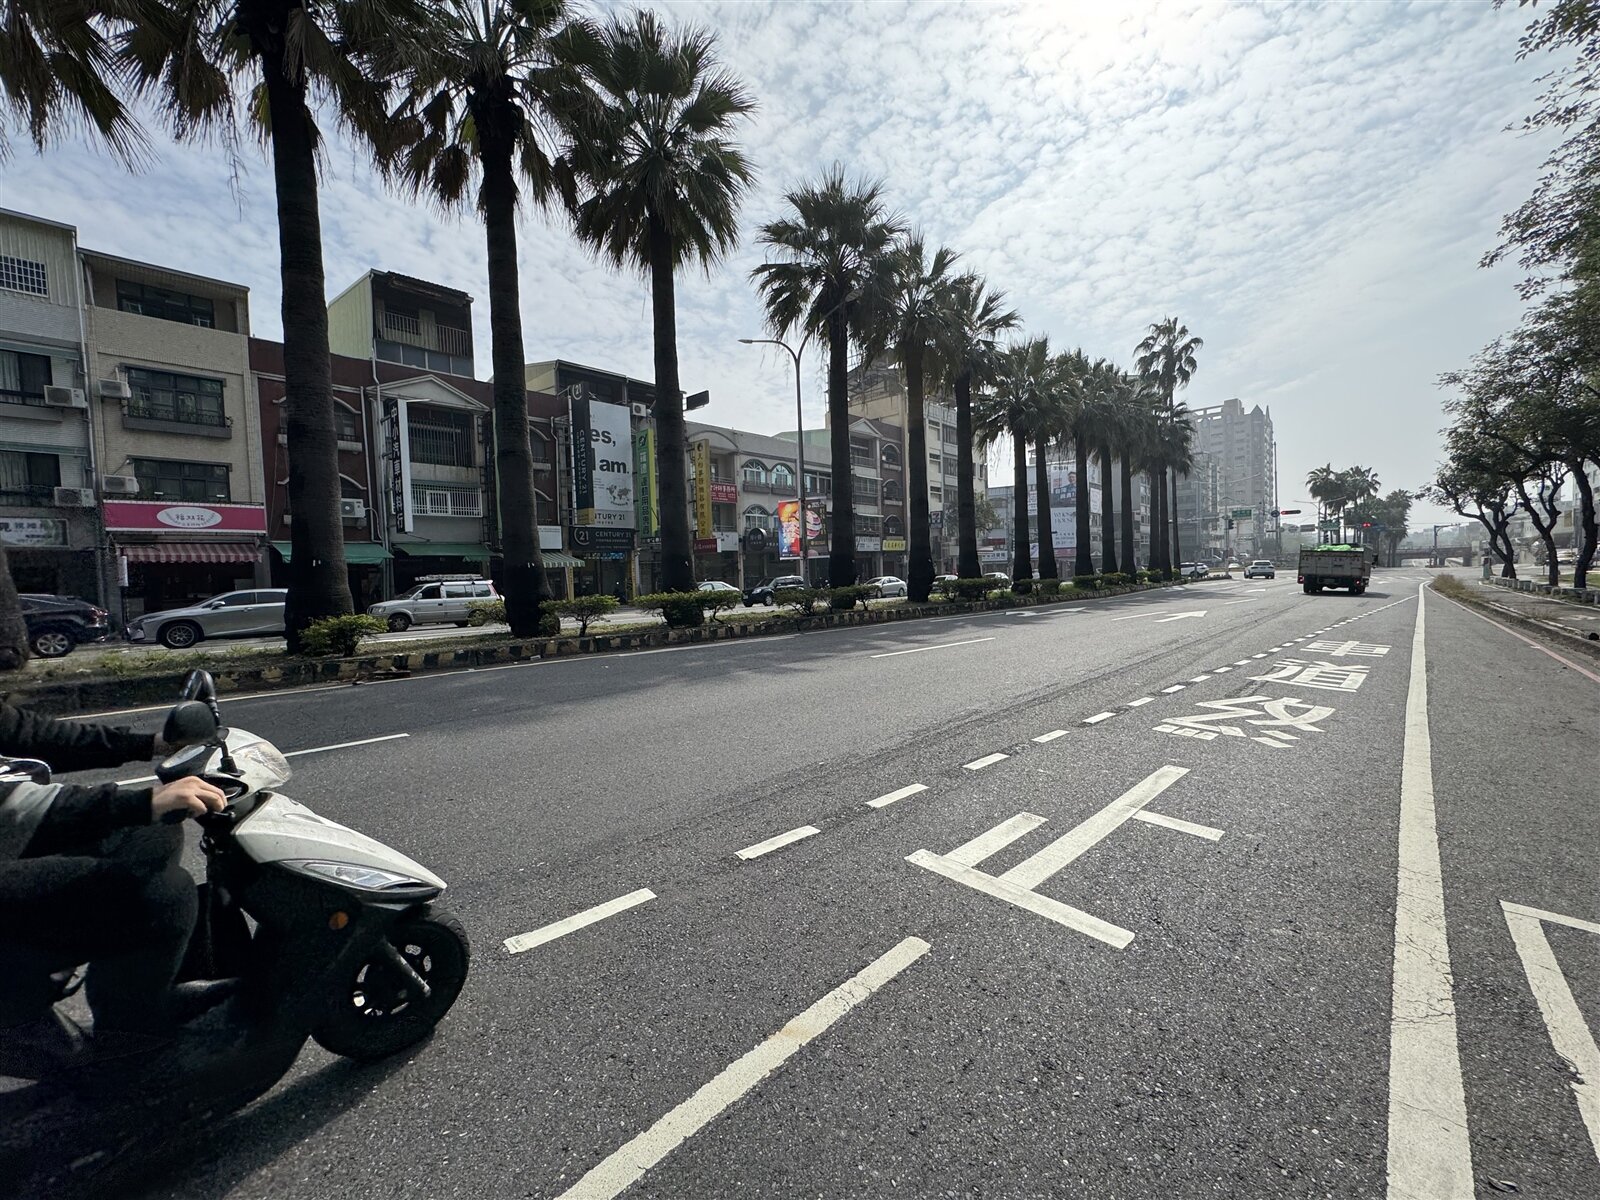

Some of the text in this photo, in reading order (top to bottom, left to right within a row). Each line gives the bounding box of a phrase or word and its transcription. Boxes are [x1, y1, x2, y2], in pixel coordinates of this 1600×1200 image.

[591, 428, 616, 447] es,
[579, 429, 587, 481] CENTURY
[599, 459, 630, 474] am.
